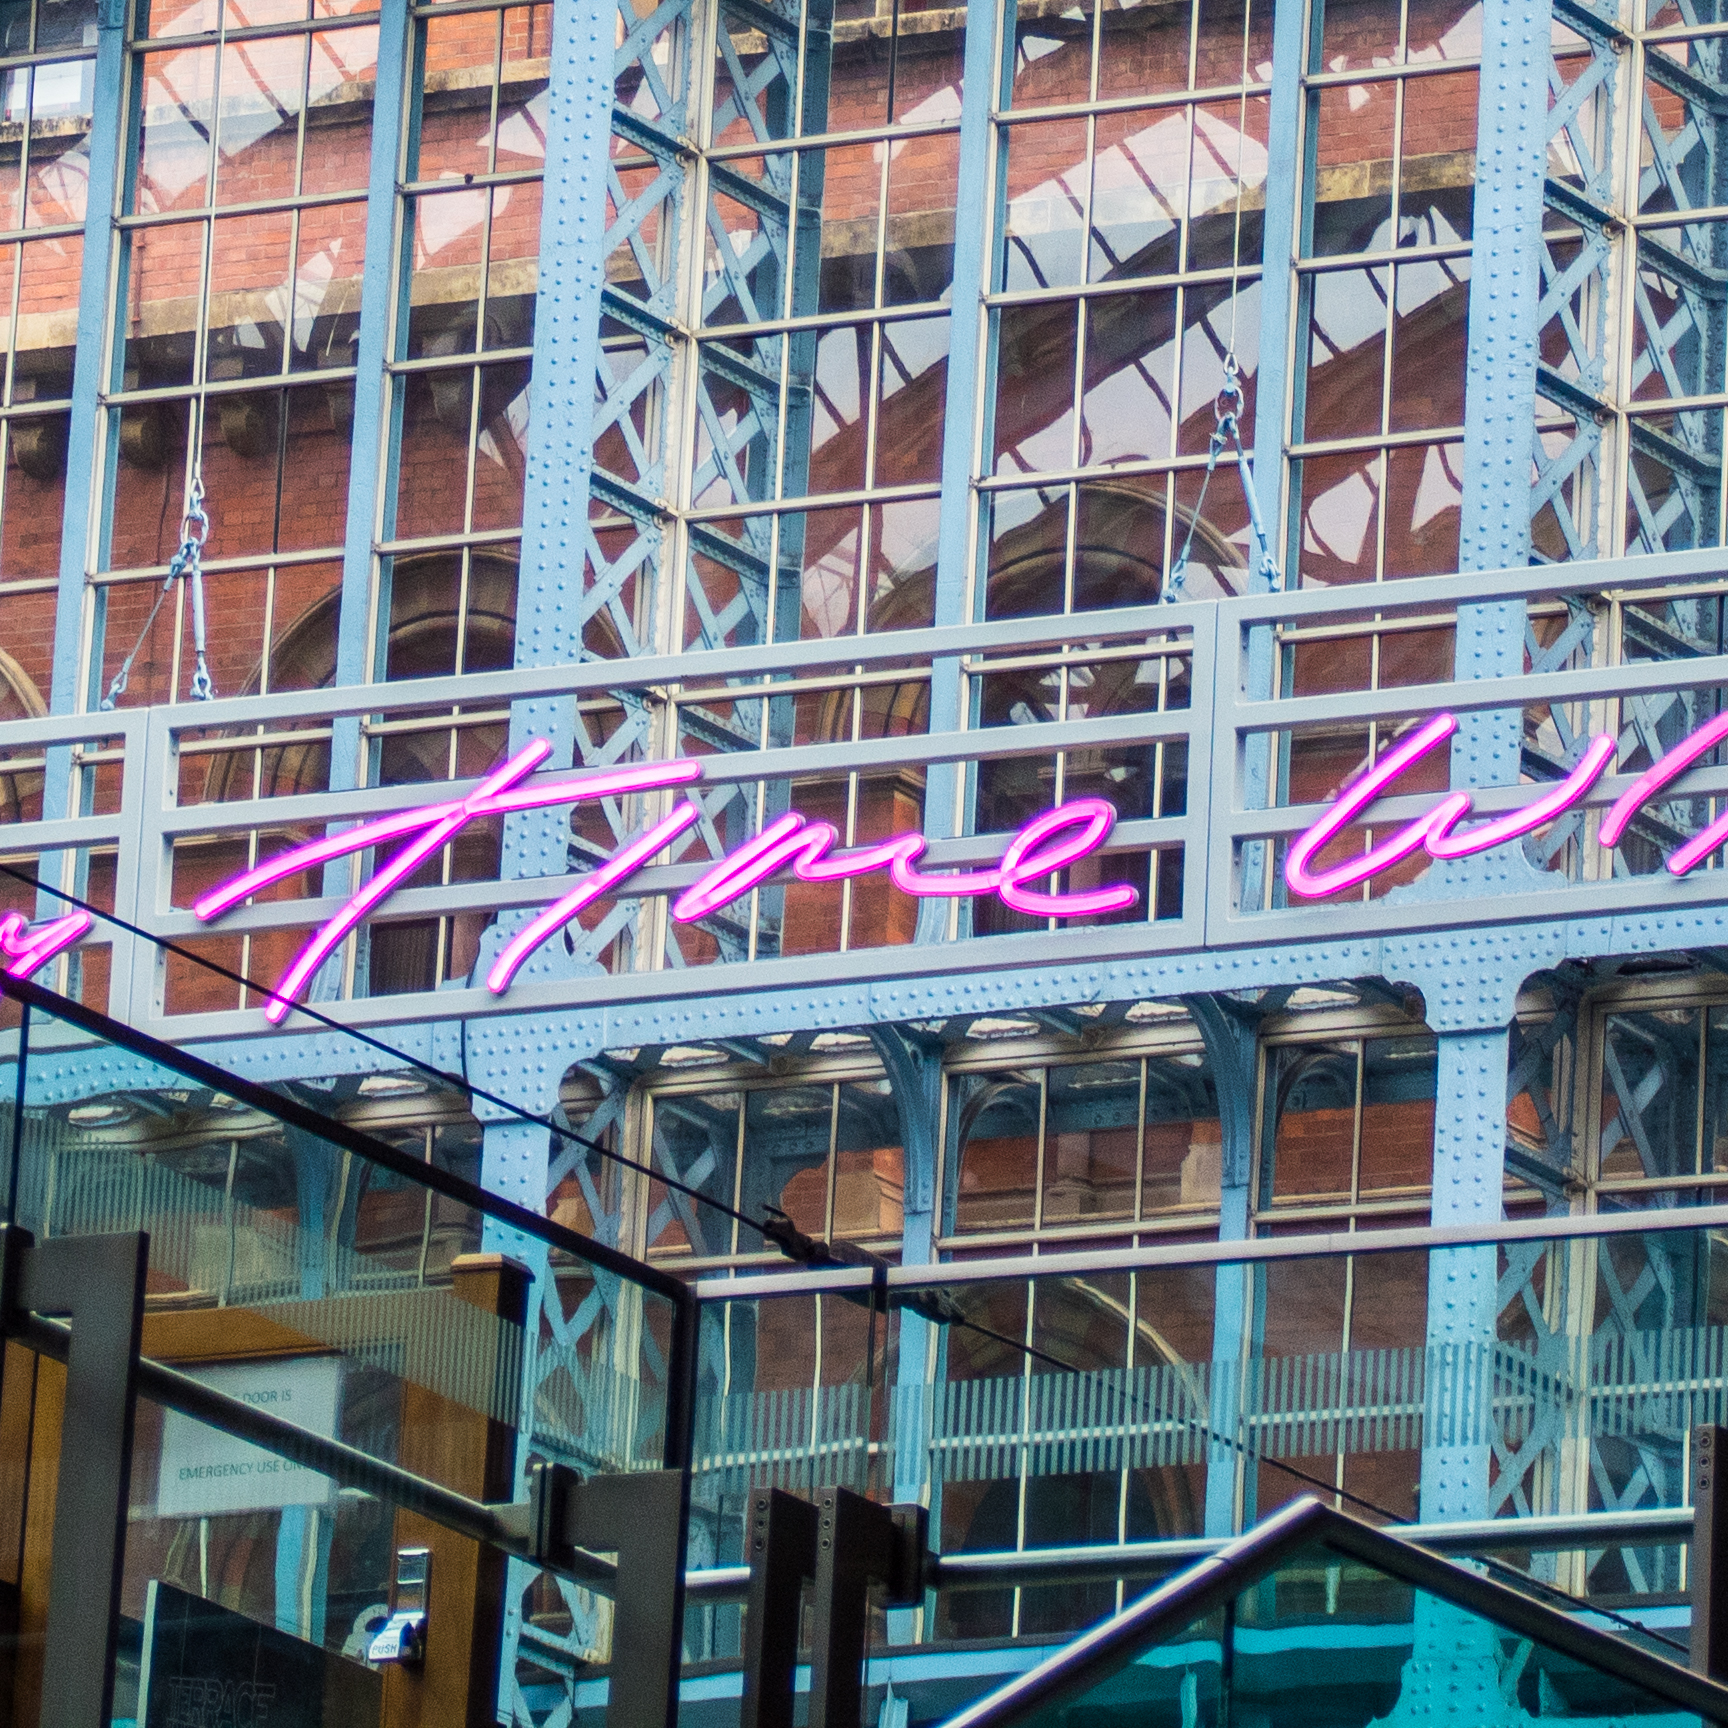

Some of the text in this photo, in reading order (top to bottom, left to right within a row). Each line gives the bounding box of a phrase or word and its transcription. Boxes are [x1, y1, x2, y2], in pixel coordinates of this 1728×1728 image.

[193, 736, 1142, 1028] Time
[179, 1462, 253, 1480] EMERGENCY
[257, 1460, 280, 1474] USE
